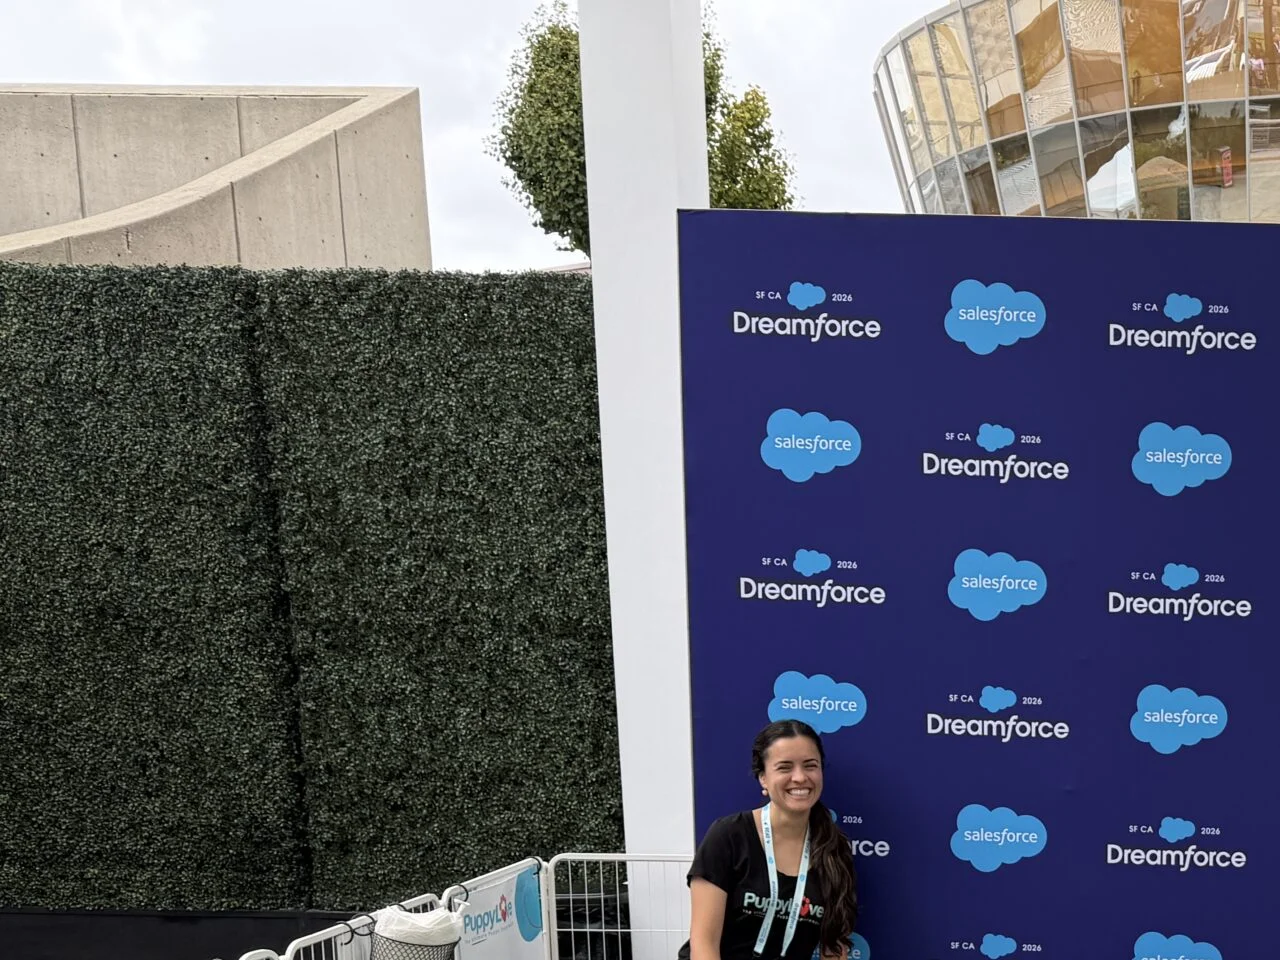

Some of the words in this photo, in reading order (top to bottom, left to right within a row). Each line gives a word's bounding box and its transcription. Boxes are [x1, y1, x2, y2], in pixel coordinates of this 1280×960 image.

[959, 306, 1036, 325] salesforce
[1209, 305, 1228, 313] 2026
[734, 312, 880, 342] Dreamforce
[1110, 324, 1256, 354] Dreamforce
[775, 435, 851, 453] salesforce
[1146, 449, 1222, 467] salesforce
[923, 453, 1069, 483] Dreamforce
[774, 558, 787, 566] CA
[740, 578, 885, 607] Dreamforce
[962, 575, 1037, 592] salesforce
[1109, 592, 1251, 621] Dreamforce
[782, 696, 857, 714] salesforce
[1144, 709, 1217, 726] salesforce
[927, 714, 1069, 742] Dreamforce
[843, 816, 863, 824] 2026
[965, 828, 1037, 845] salesforce
[1107, 844, 1246, 871] Dreamforce
